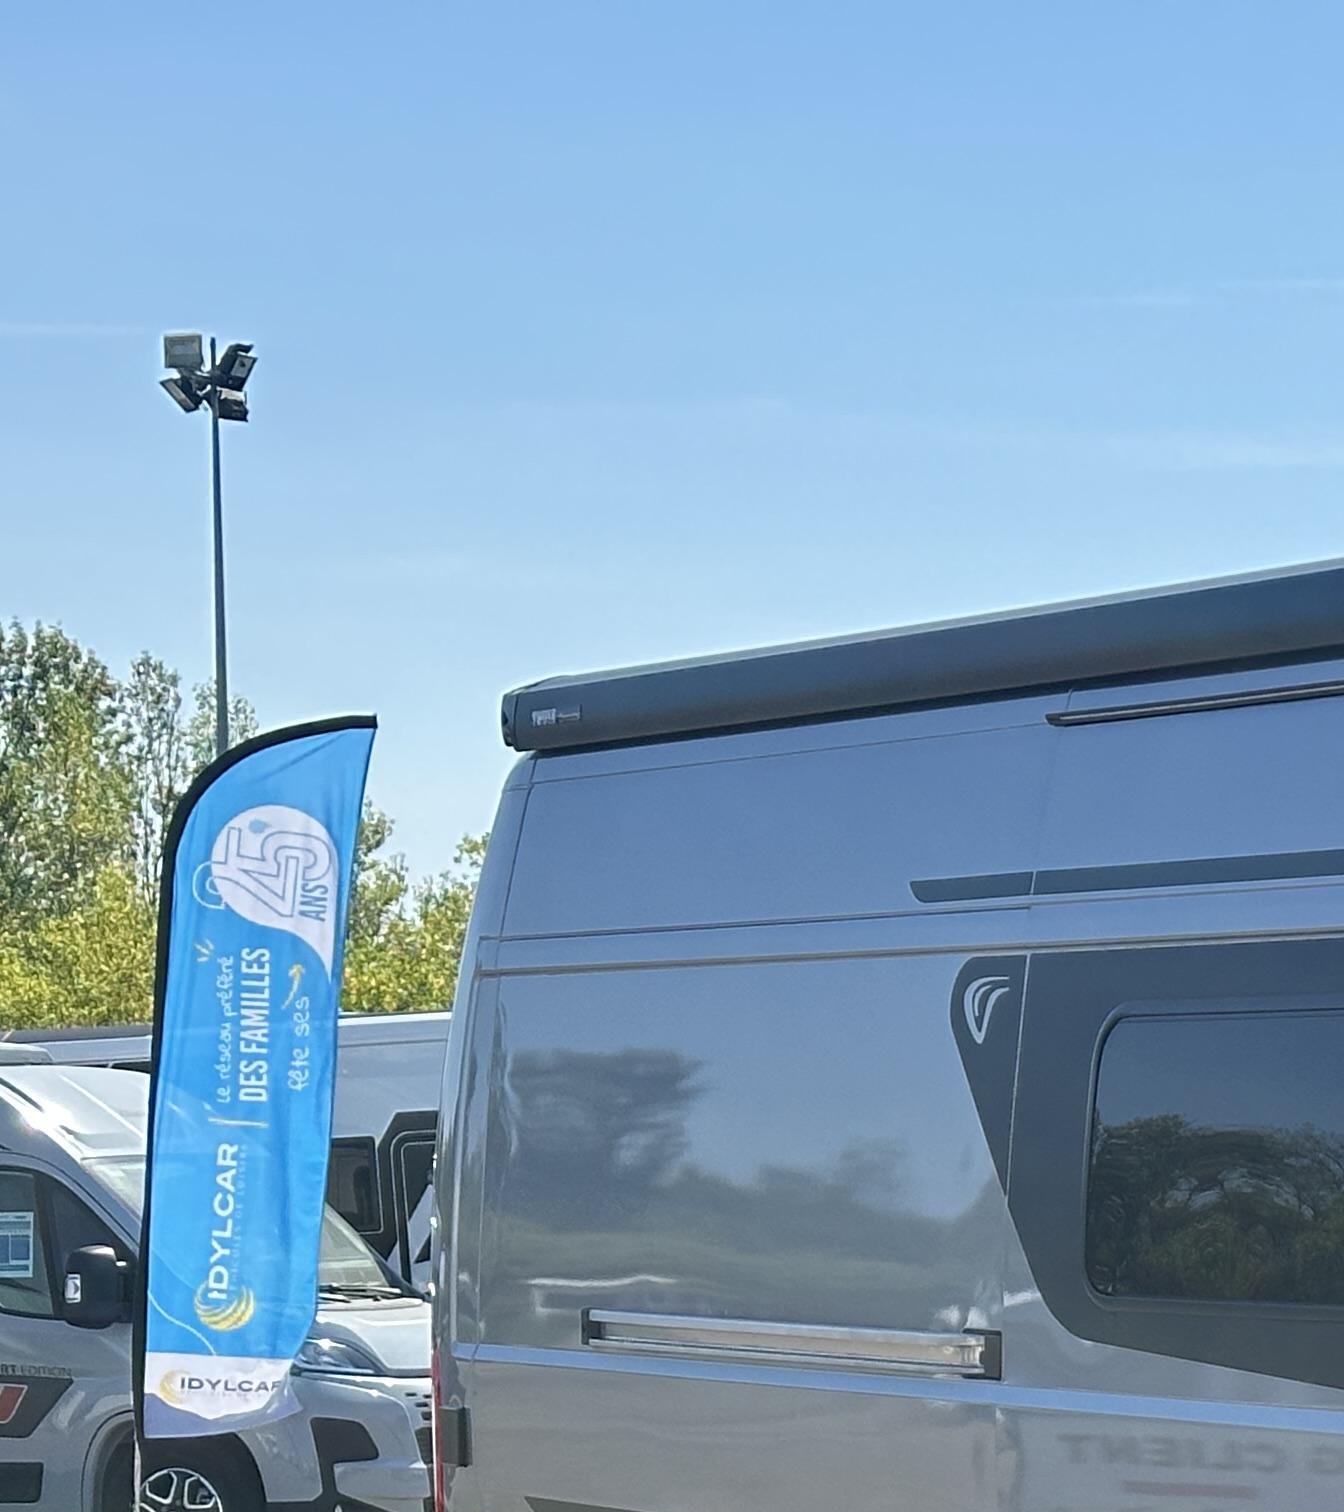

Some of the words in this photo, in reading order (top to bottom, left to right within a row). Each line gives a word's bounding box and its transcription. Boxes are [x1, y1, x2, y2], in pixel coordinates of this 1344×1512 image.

[193, 826, 331, 917] 25
[299, 882, 329, 922] ANS
[215, 955, 238, 1017] préféré
[239, 947, 271, 1054] FAMILLES
[292, 996, 310, 1037] ses
[214, 1022, 232, 1080] réseau
[287, 1046, 310, 1091] fête
[238, 1059, 269, 1102] DES
[207, 1143, 239, 1300] IDYLCAR
